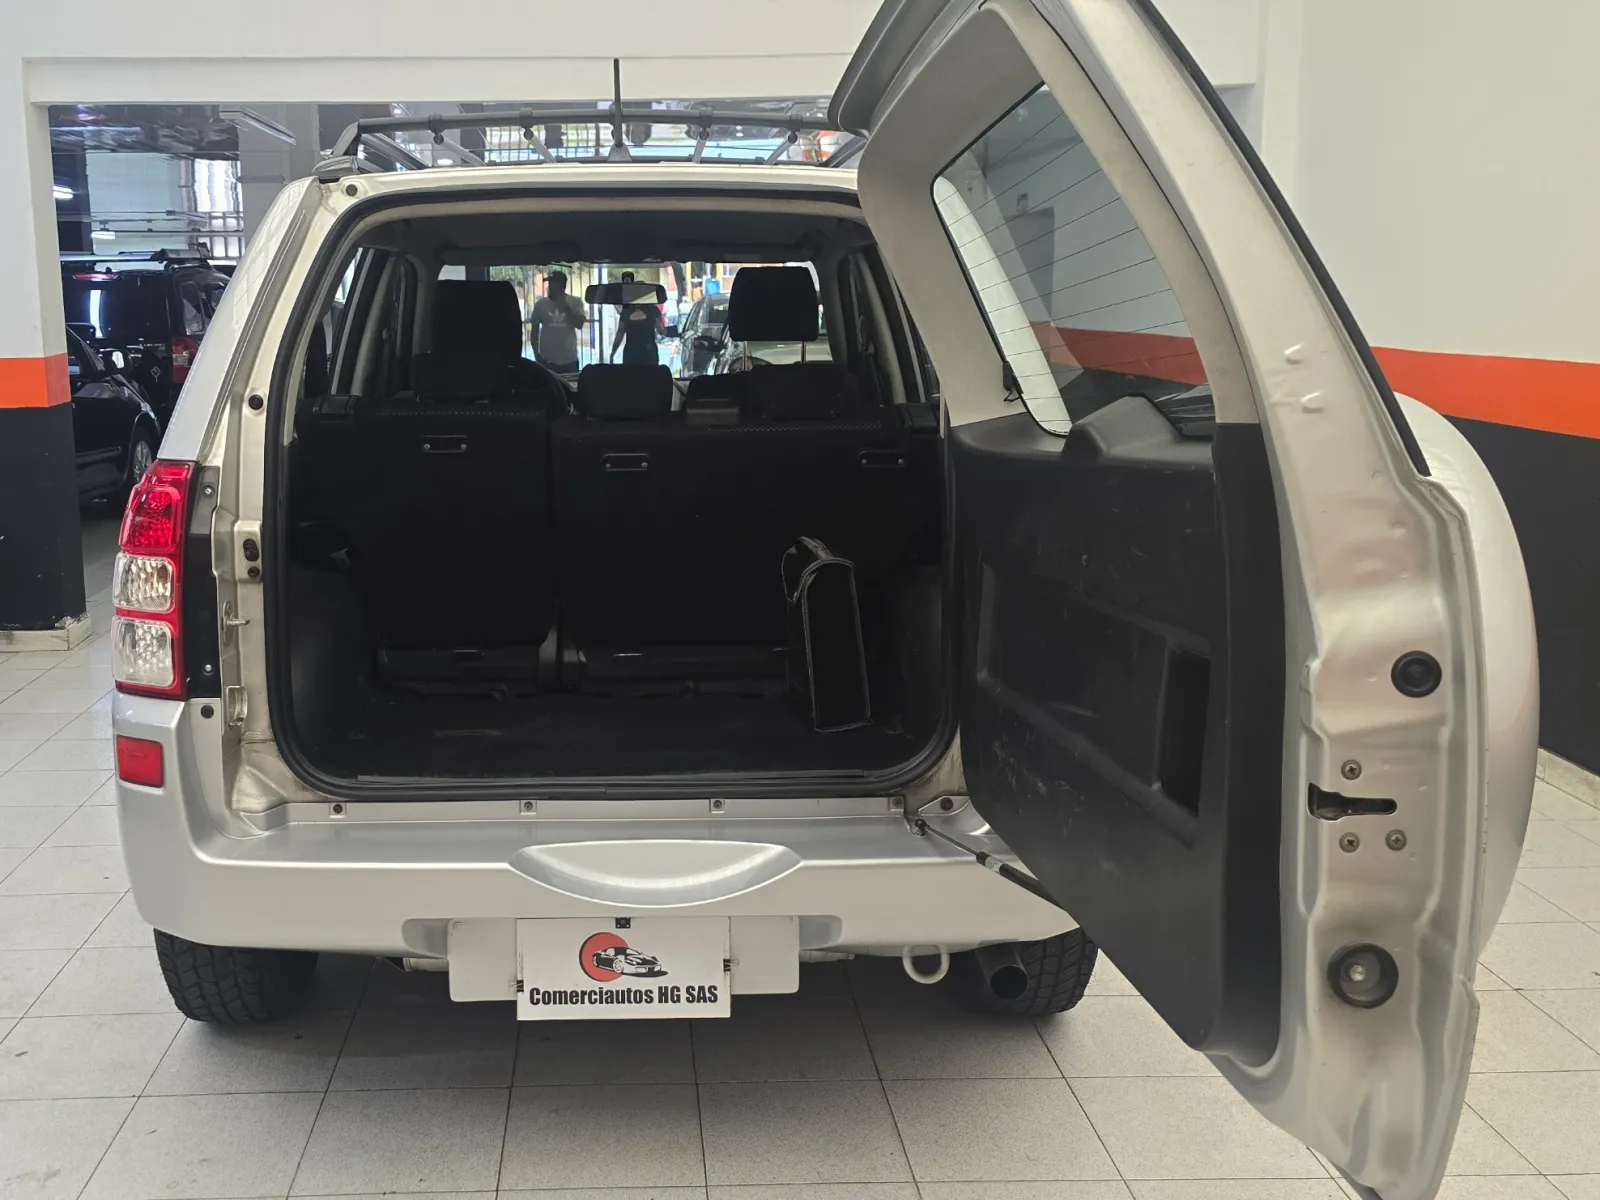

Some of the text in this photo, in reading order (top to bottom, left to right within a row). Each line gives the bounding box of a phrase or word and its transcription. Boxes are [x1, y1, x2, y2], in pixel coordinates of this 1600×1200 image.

[529, 985, 718, 1005] Comerciautos HG SAS
